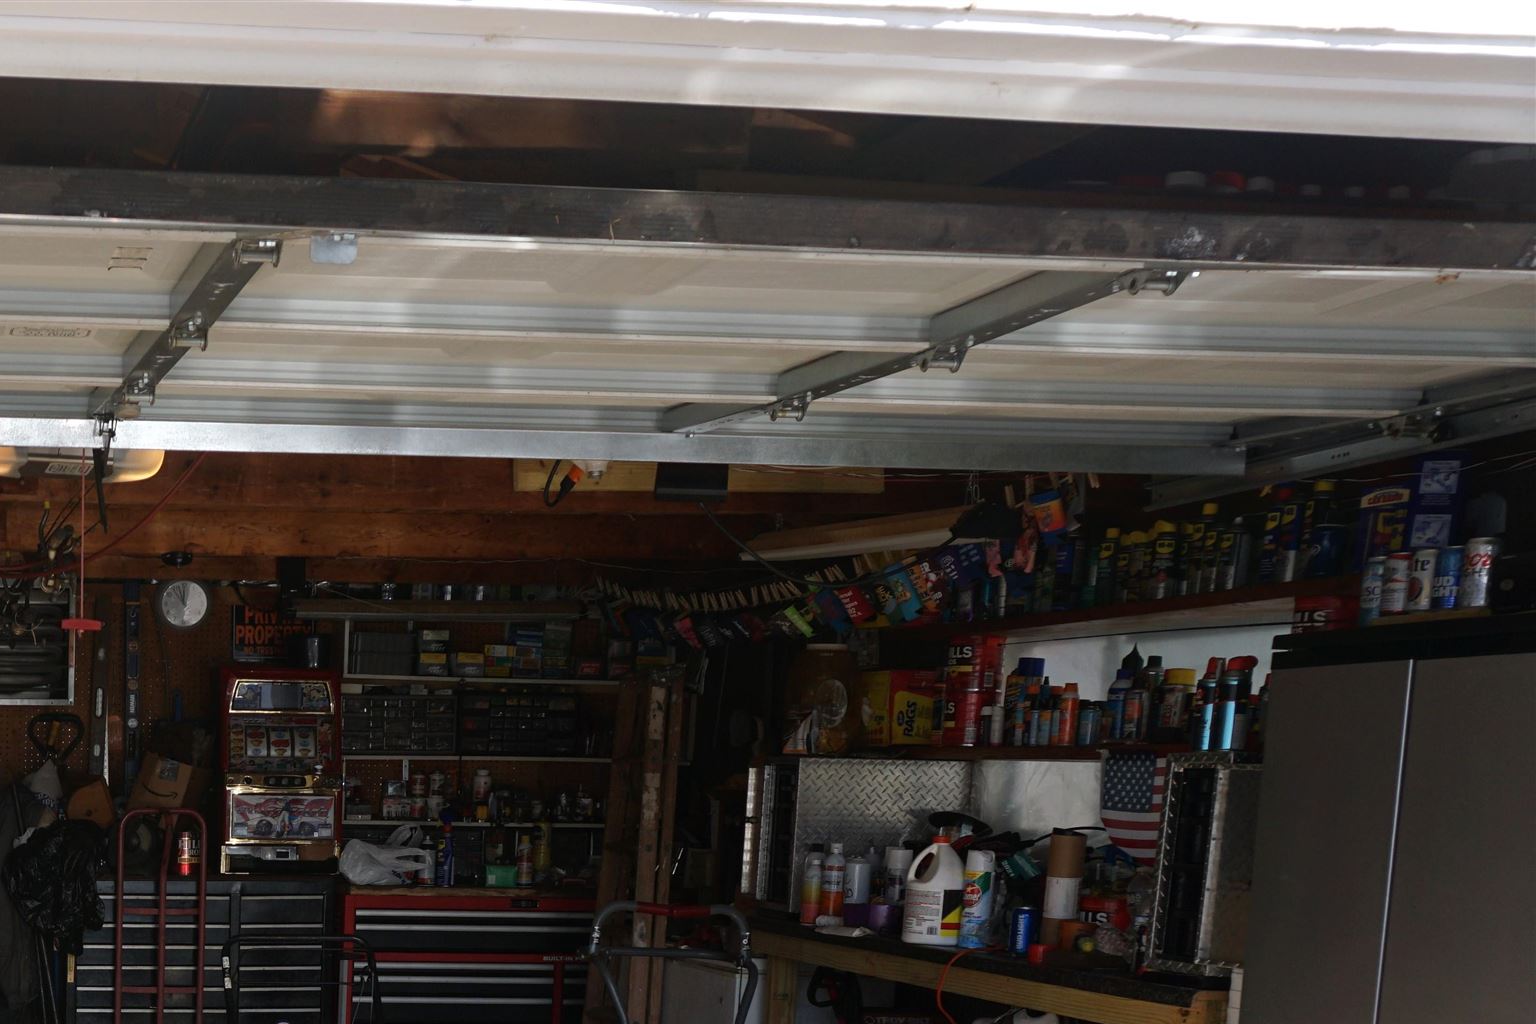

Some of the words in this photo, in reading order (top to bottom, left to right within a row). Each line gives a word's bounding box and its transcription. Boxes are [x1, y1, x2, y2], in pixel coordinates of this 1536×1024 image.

[949, 646, 972, 659] LLS
[904, 700, 917, 736] RAGS
[1080, 911, 1108, 926] LLS
